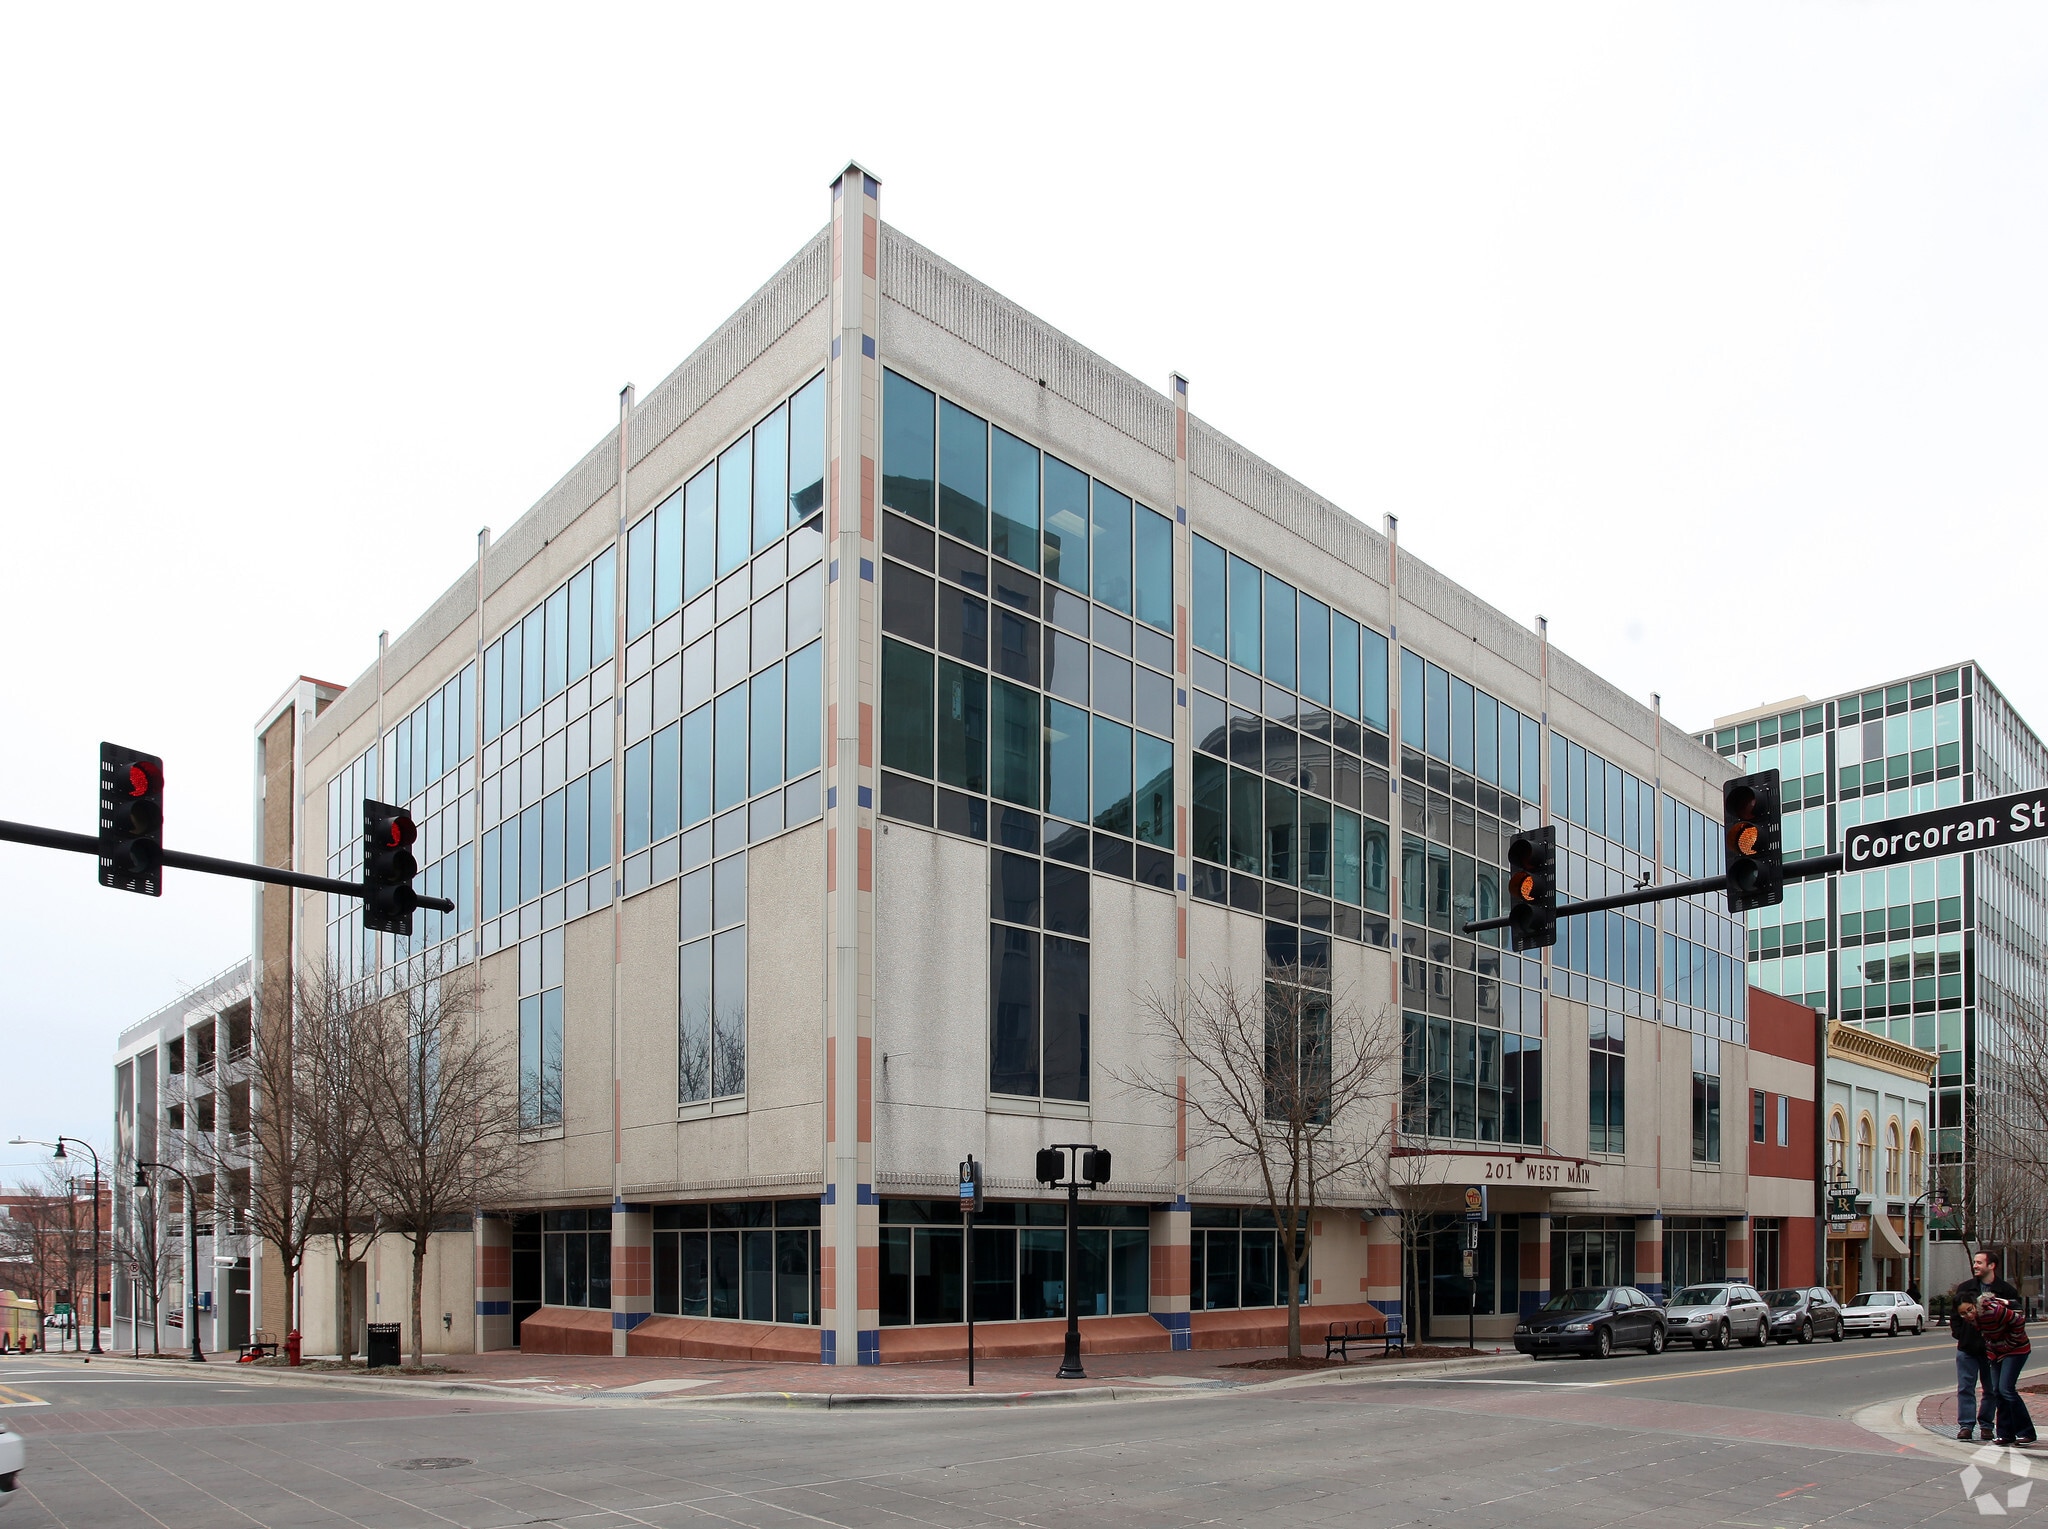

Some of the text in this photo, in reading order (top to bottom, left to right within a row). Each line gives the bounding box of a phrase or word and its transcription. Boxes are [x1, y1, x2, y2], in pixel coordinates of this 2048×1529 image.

[1851, 800, 2046, 862] Corcoran St
[1485, 1162, 1590, 1184] 201 WEST MAIN
